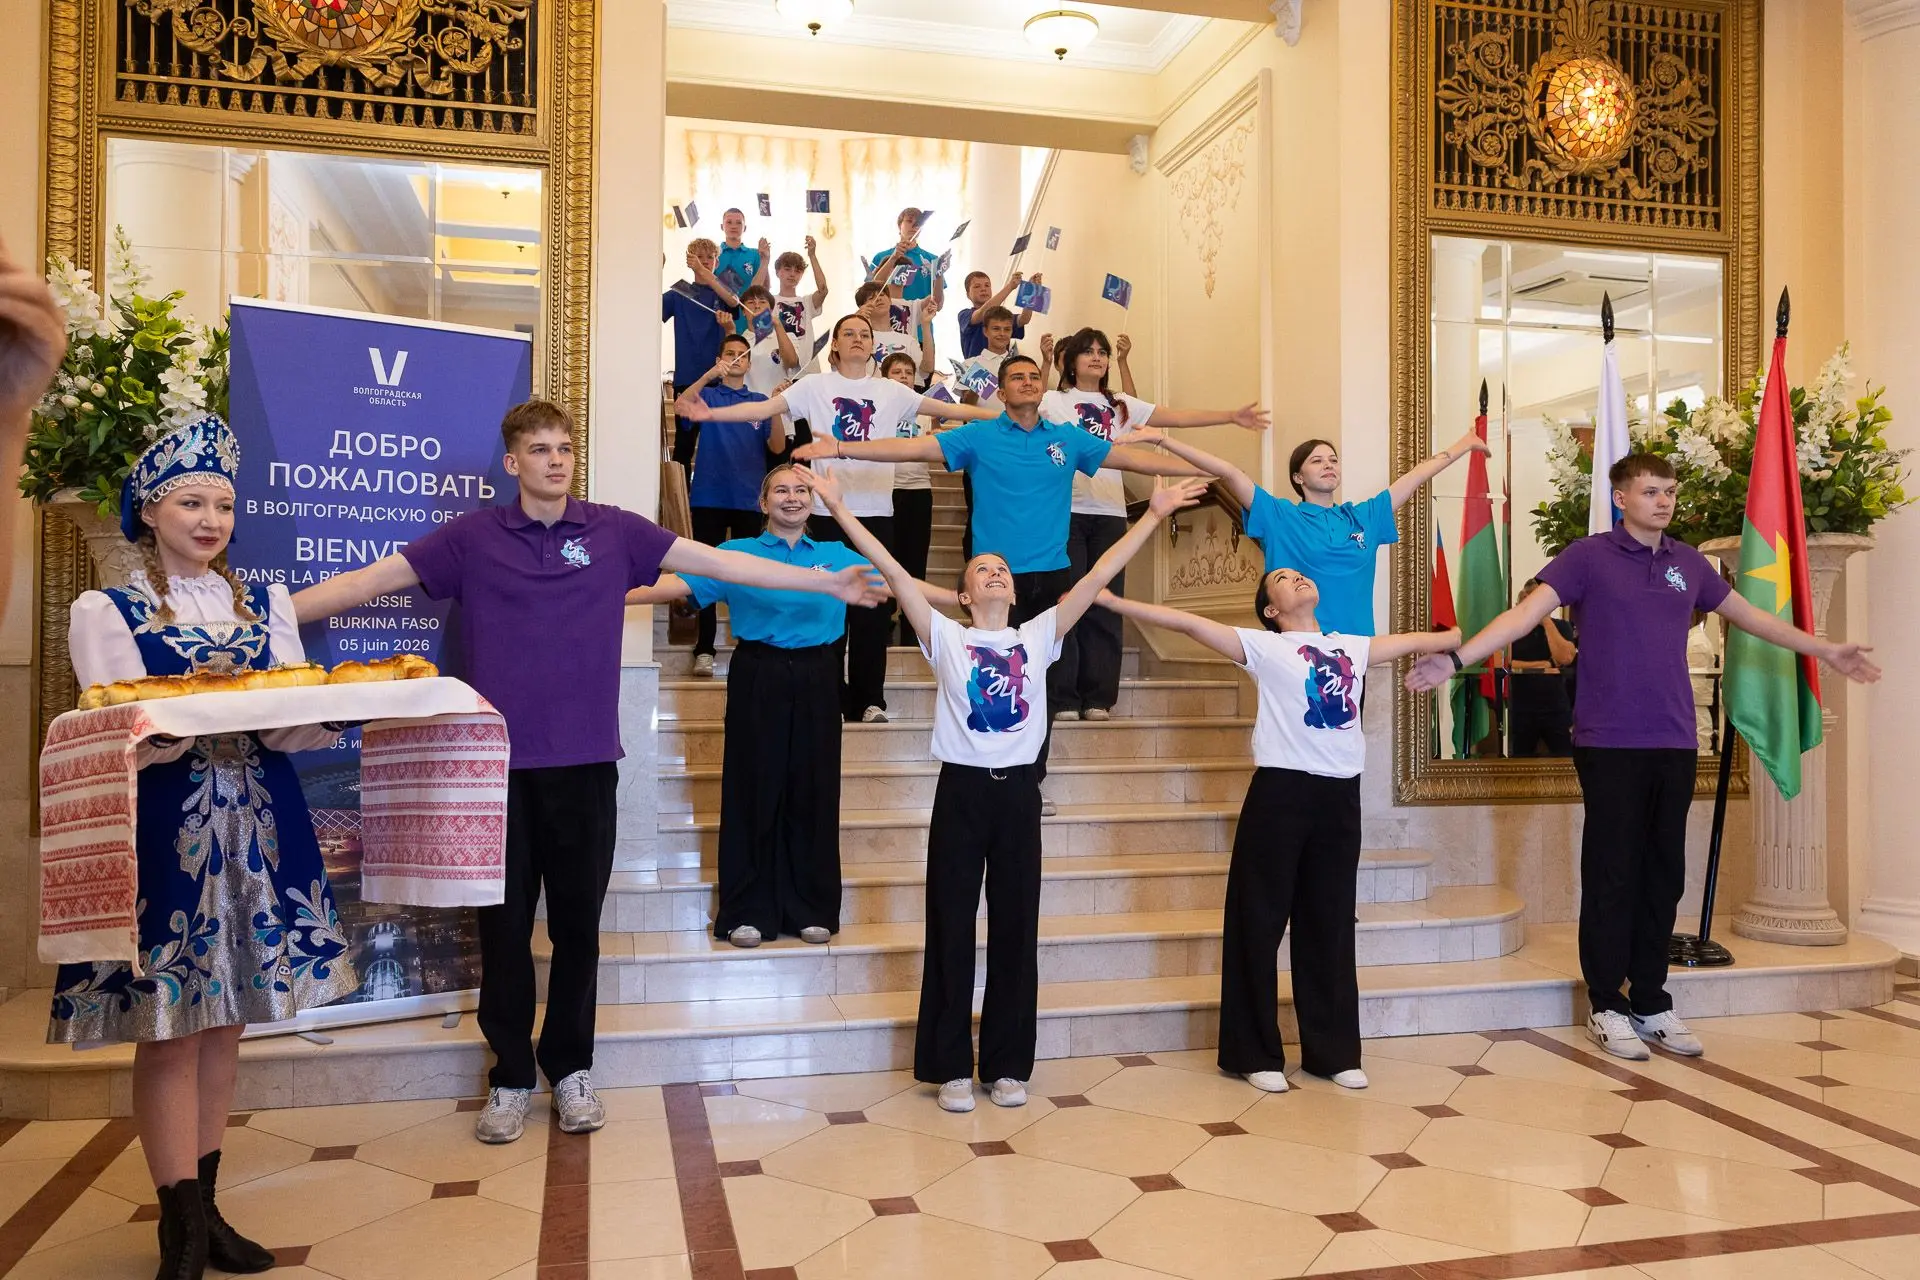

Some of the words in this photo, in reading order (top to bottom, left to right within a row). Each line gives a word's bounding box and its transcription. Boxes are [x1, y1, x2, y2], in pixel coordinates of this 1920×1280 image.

[368, 346, 408, 387] V
[353, 386, 422, 400] ВОЛГОГРАДСКАЯ
[369, 397, 407, 407] ОБЛАСТЬ
[329, 429, 442, 461] ДОБРО
[269, 461, 496, 499] ПОЖАЛОВАТЬ
[246, 500, 258, 514] В
[264, 501, 427, 523] ВОЛГОГРАДСКУЮ
[235, 567, 286, 583] DANS
[291, 569, 315, 584] LA
[329, 616, 398, 630] BURKINA
[401, 617, 440, 630] FASO
[339, 638, 359, 651] 05
[362, 638, 389, 654] juin
[393, 639, 430, 651] 2026
